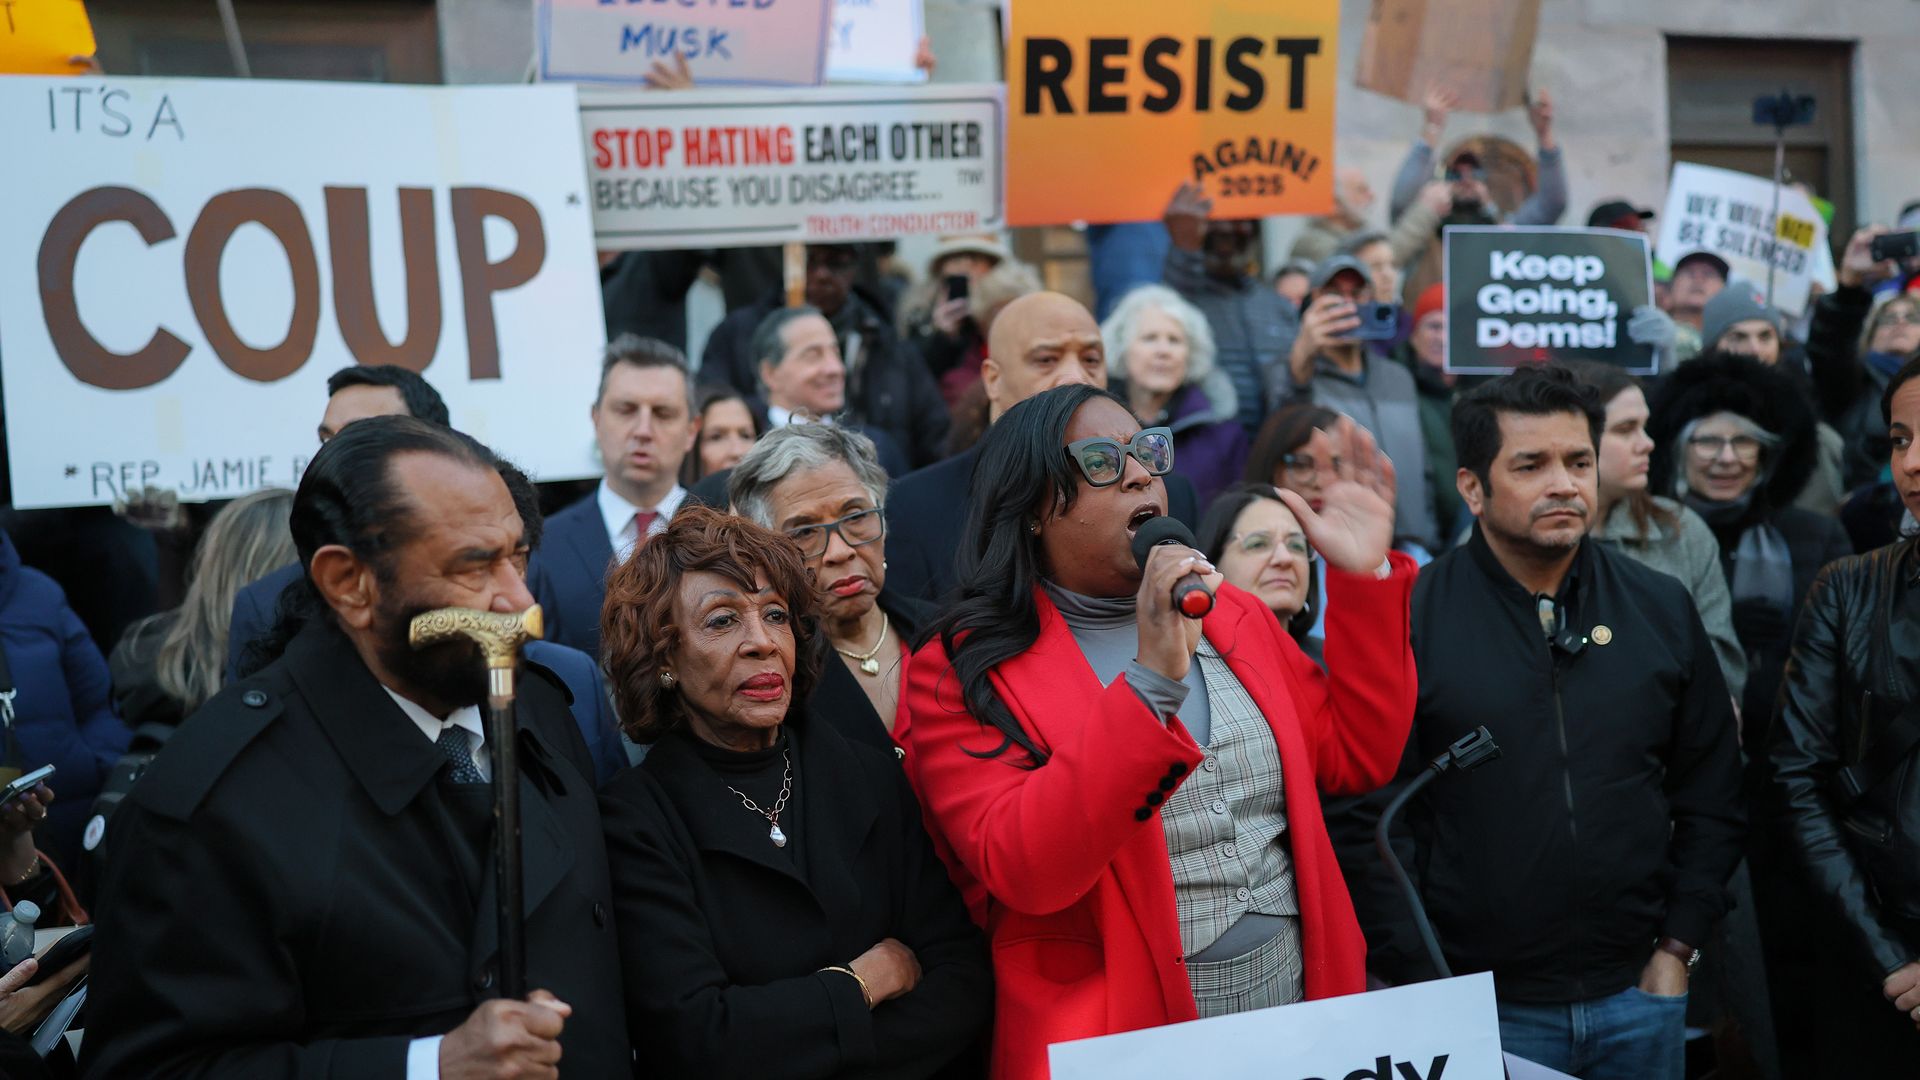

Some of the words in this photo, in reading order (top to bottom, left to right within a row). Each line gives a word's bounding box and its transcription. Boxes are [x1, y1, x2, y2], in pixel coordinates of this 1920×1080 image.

[619, 23, 732, 60] MUSK
[1023, 37, 1322, 116] RESIST
[47, 85, 132, 137] IT'S
[147, 93, 185, 141] A
[592, 127, 674, 170] STOP
[683, 123, 795, 168] HATING
[804, 123, 880, 164] EACH
[890, 121, 982, 162] OTHER
[1191, 136, 1321, 182] AGAIN!
[595, 175, 721, 211] BECAUSE
[727, 172, 783, 207] YOU
[1218, 174, 1285, 197] 2025
[807, 214, 863, 238] TRUTH
[869, 210, 978, 236] CONDUCTOR
[1490, 250, 1605, 286] Keep
[37, 185, 546, 390] COUP
[1477, 283, 1618, 320] Going,
[1477, 317, 1617, 349] Dems!
[180, 456, 272, 493] JAMIE
